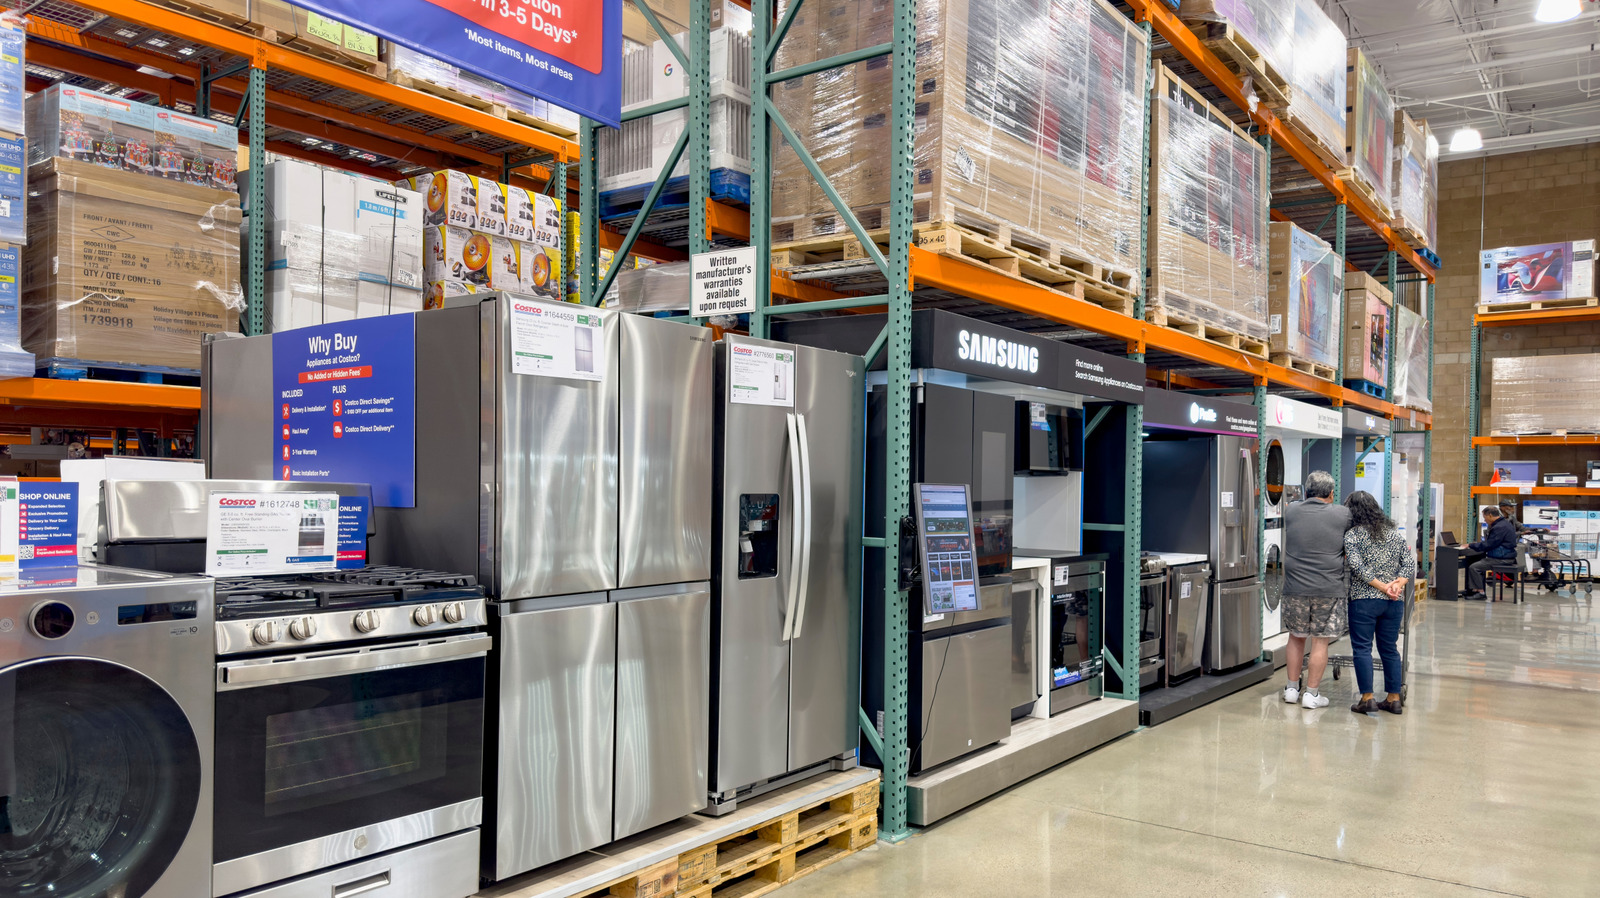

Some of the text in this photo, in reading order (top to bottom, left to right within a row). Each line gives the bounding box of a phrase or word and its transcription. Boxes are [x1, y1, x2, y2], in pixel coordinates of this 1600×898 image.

[499, 0, 527, 25] 3-5
[495, 40, 523, 63] items,
[525, 53, 548, 71] Most
[550, 67, 573, 81] areas
[8, 143, 21, 151] UHD
[83, 214, 103, 222] FRONT
[132, 222, 154, 230] FRENTE
[710, 256, 737, 267] Written
[84, 269, 99, 277] QTY
[696, 264, 752, 280] manufacturer's
[704, 277, 743, 289] warranties
[706, 288, 740, 300] available
[700, 297, 747, 312] upon request
[82, 314, 133, 328] 1739918
[544, 311, 574, 321] #1644559
[308, 333, 358, 356] Why Buy
[958, 329, 1040, 374] SAMSUNG
[306, 356, 331, 368] Appliances
[338, 354, 360, 363] Costco?
[1075, 359, 1084, 368] Find
[332, 370, 348, 378] Hidden
[1075, 371, 1088, 380] Search
[1088, 374, 1104, 386] Samsung
[1104, 377, 1121, 387] Appliances
[282, 389, 303, 398] INCLUDED
[332, 385, 346, 394] PLUS
